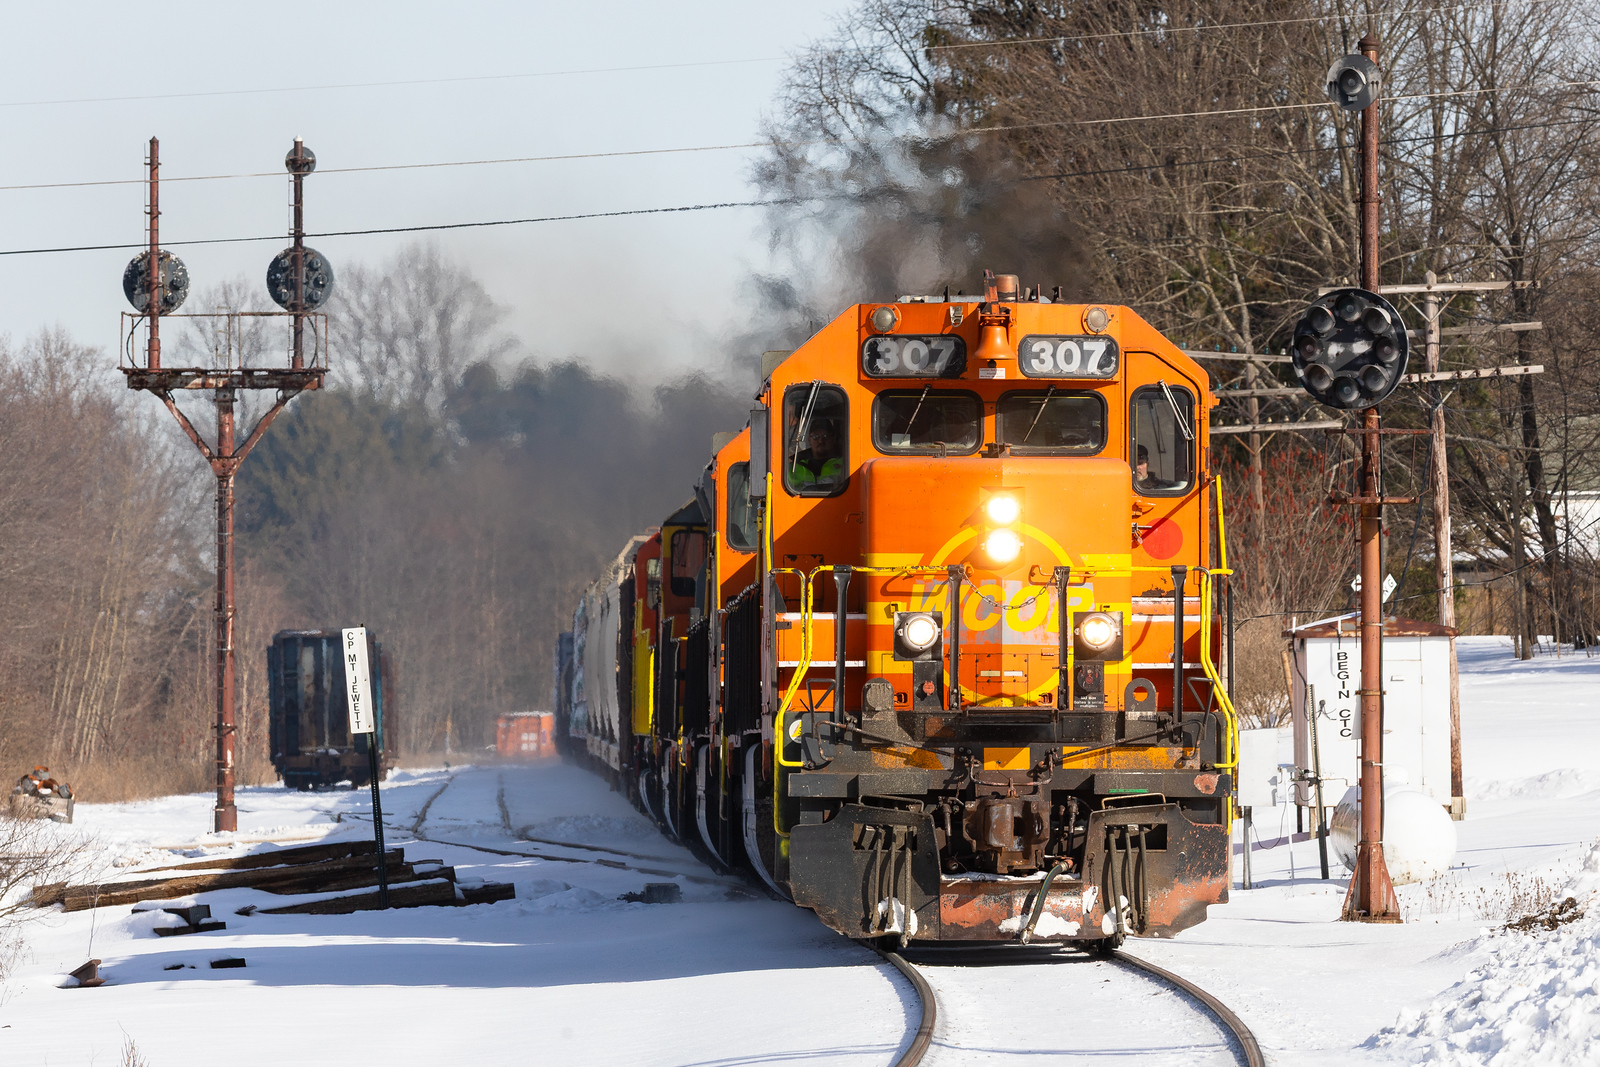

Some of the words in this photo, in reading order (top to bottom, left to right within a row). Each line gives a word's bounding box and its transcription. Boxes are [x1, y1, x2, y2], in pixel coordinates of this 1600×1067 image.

[876, 340, 956, 371] 307
[1031, 340, 1107, 372] 307
[346, 631, 355, 650] CP
[348, 653, 357, 672] MT
[1336, 651, 1350, 700] BEGIN
[351, 675, 361, 730] JEWETT
[1338, 708, 1353, 738] CTC
